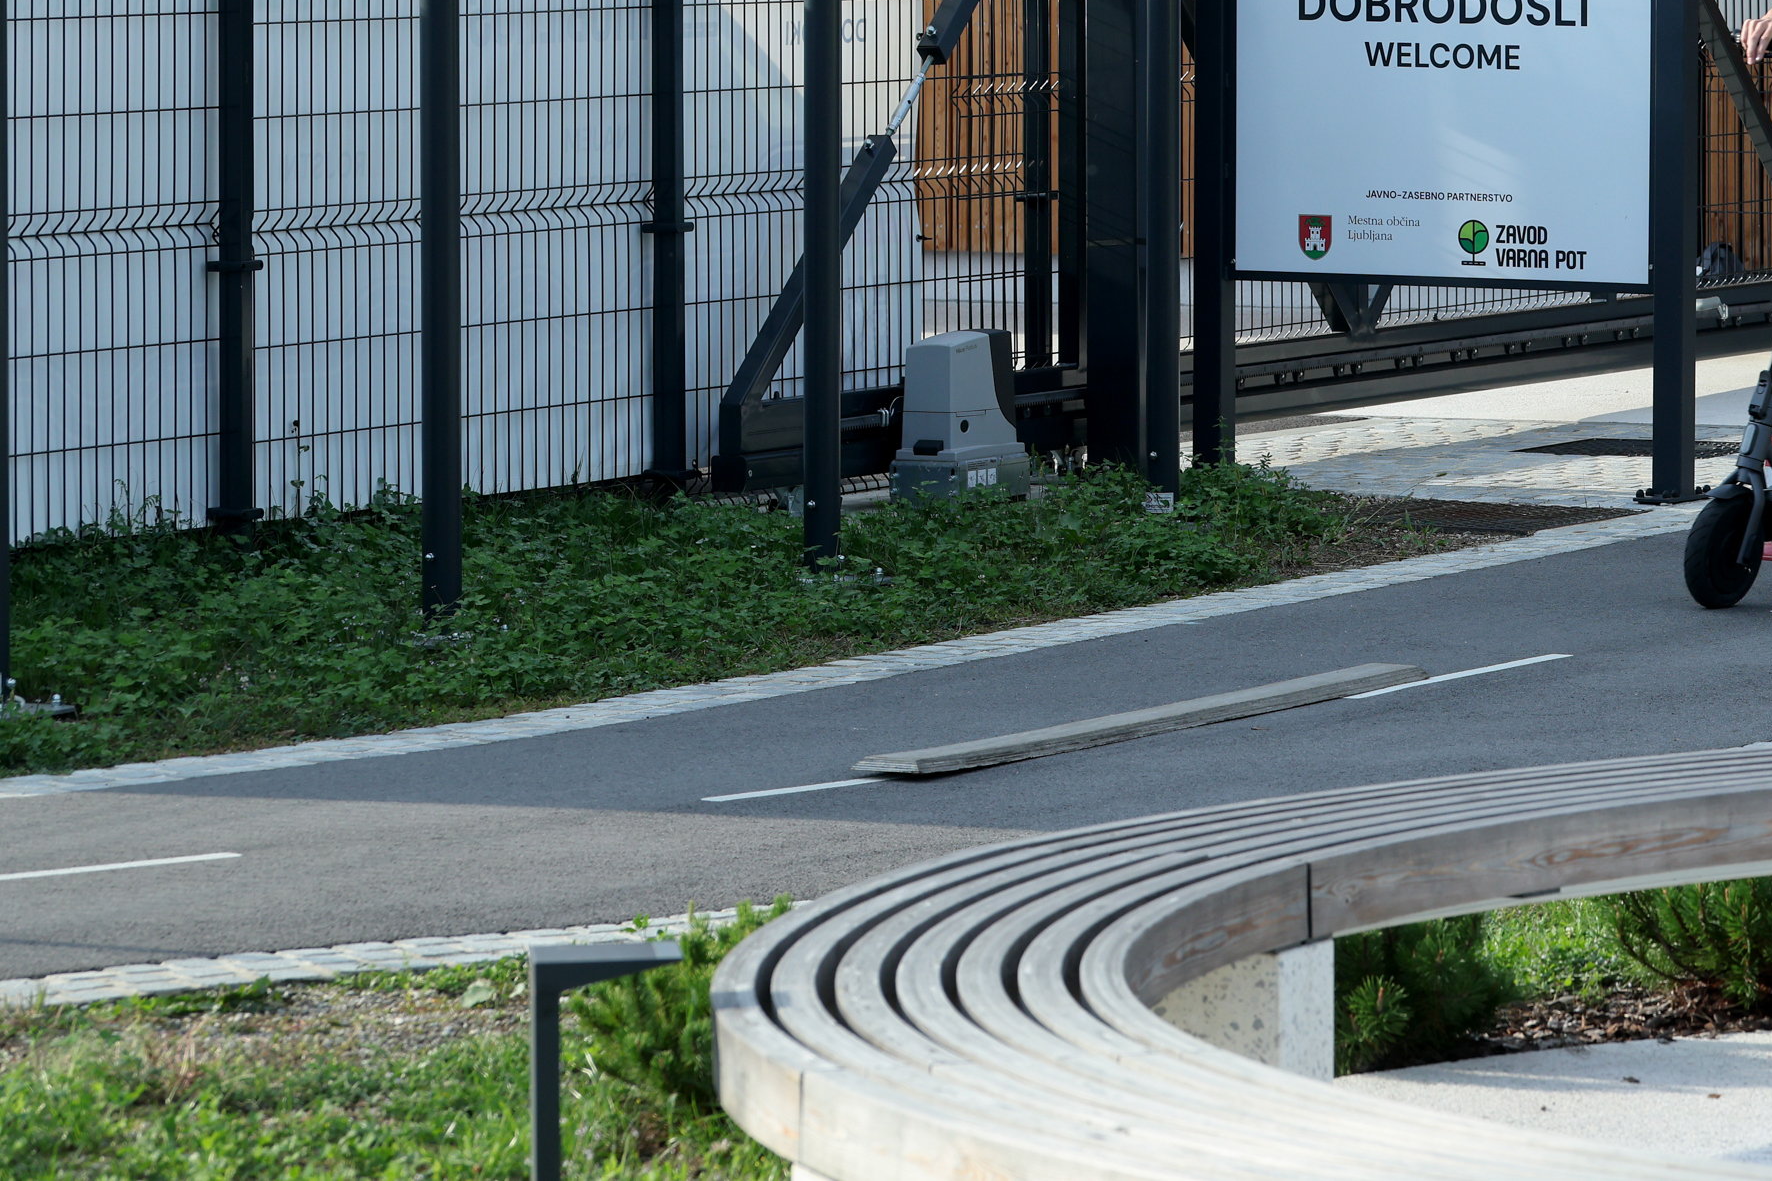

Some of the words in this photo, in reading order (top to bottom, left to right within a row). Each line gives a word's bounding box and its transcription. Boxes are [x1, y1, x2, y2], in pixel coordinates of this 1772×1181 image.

[1364, 41, 1521, 71] WELCOME
[1365, 189, 1445, 201] JAVNO-ZASEBNO
[1446, 192, 1513, 204] PARTNERSTVO
[1347, 215, 1384, 226] Mestna
[1386, 215, 1421, 227] občina
[1347, 229, 1393, 243] Ljubljana
[1495, 224, 1548, 245] ZAVOD
[1495, 247, 1549, 269] VARNA
[1555, 249, 1588, 270] POT
